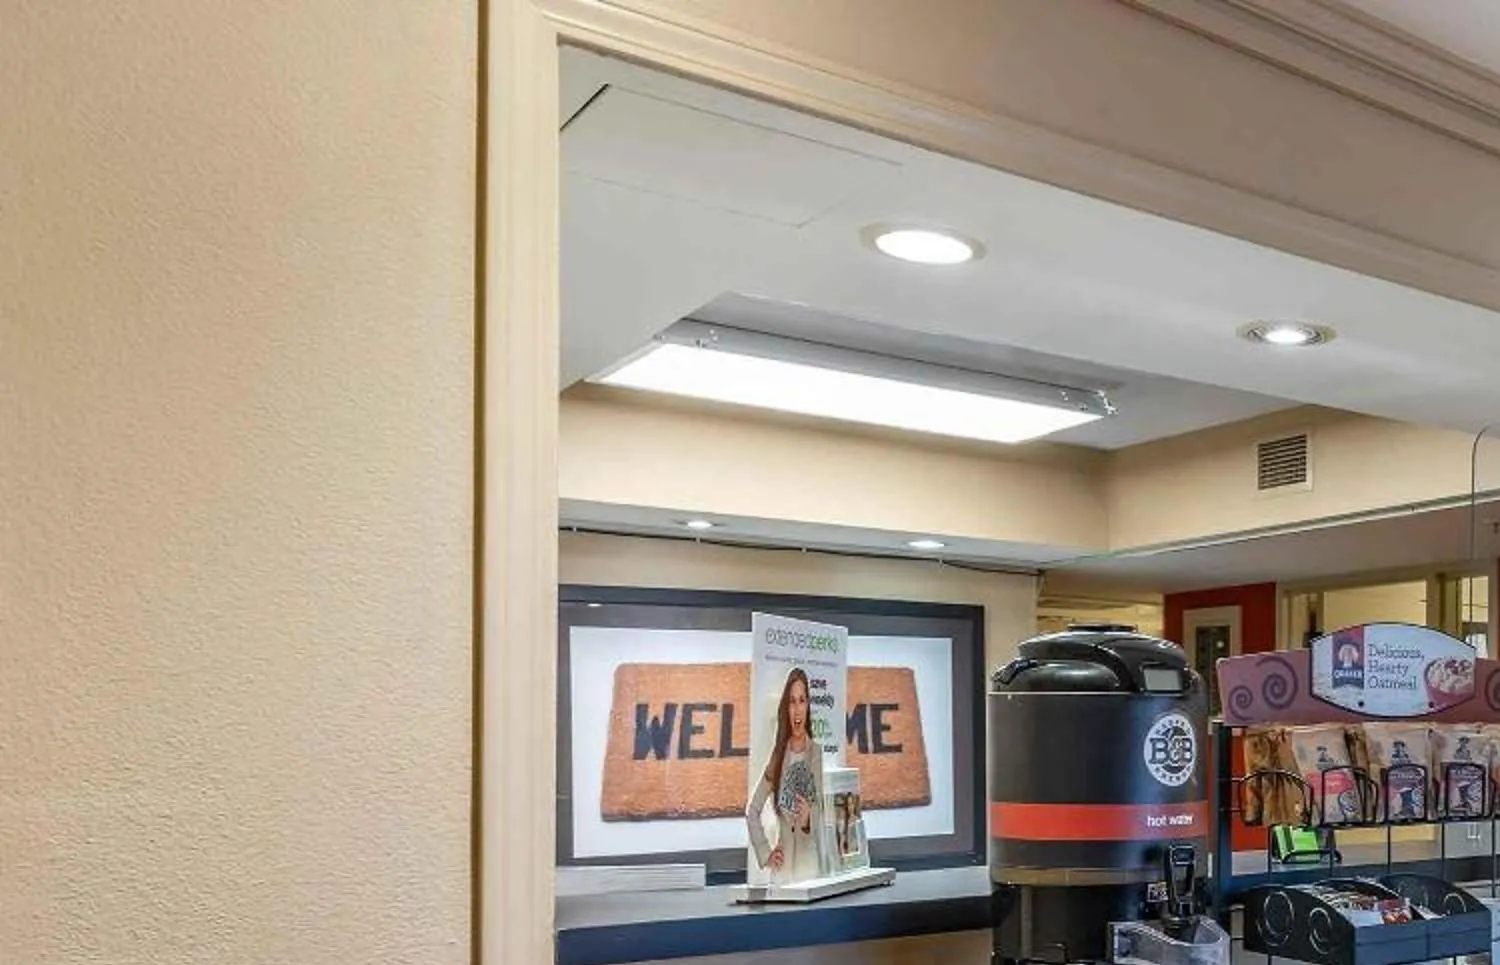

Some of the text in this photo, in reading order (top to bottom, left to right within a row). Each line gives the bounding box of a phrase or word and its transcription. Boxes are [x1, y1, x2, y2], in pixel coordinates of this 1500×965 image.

[1367, 643, 1425, 660] Delicious,
[1367, 660, 1409, 678] Hearty
[1367, 675, 1417, 690] Oatmeal
[1147, 814, 1194, 827] hot water
